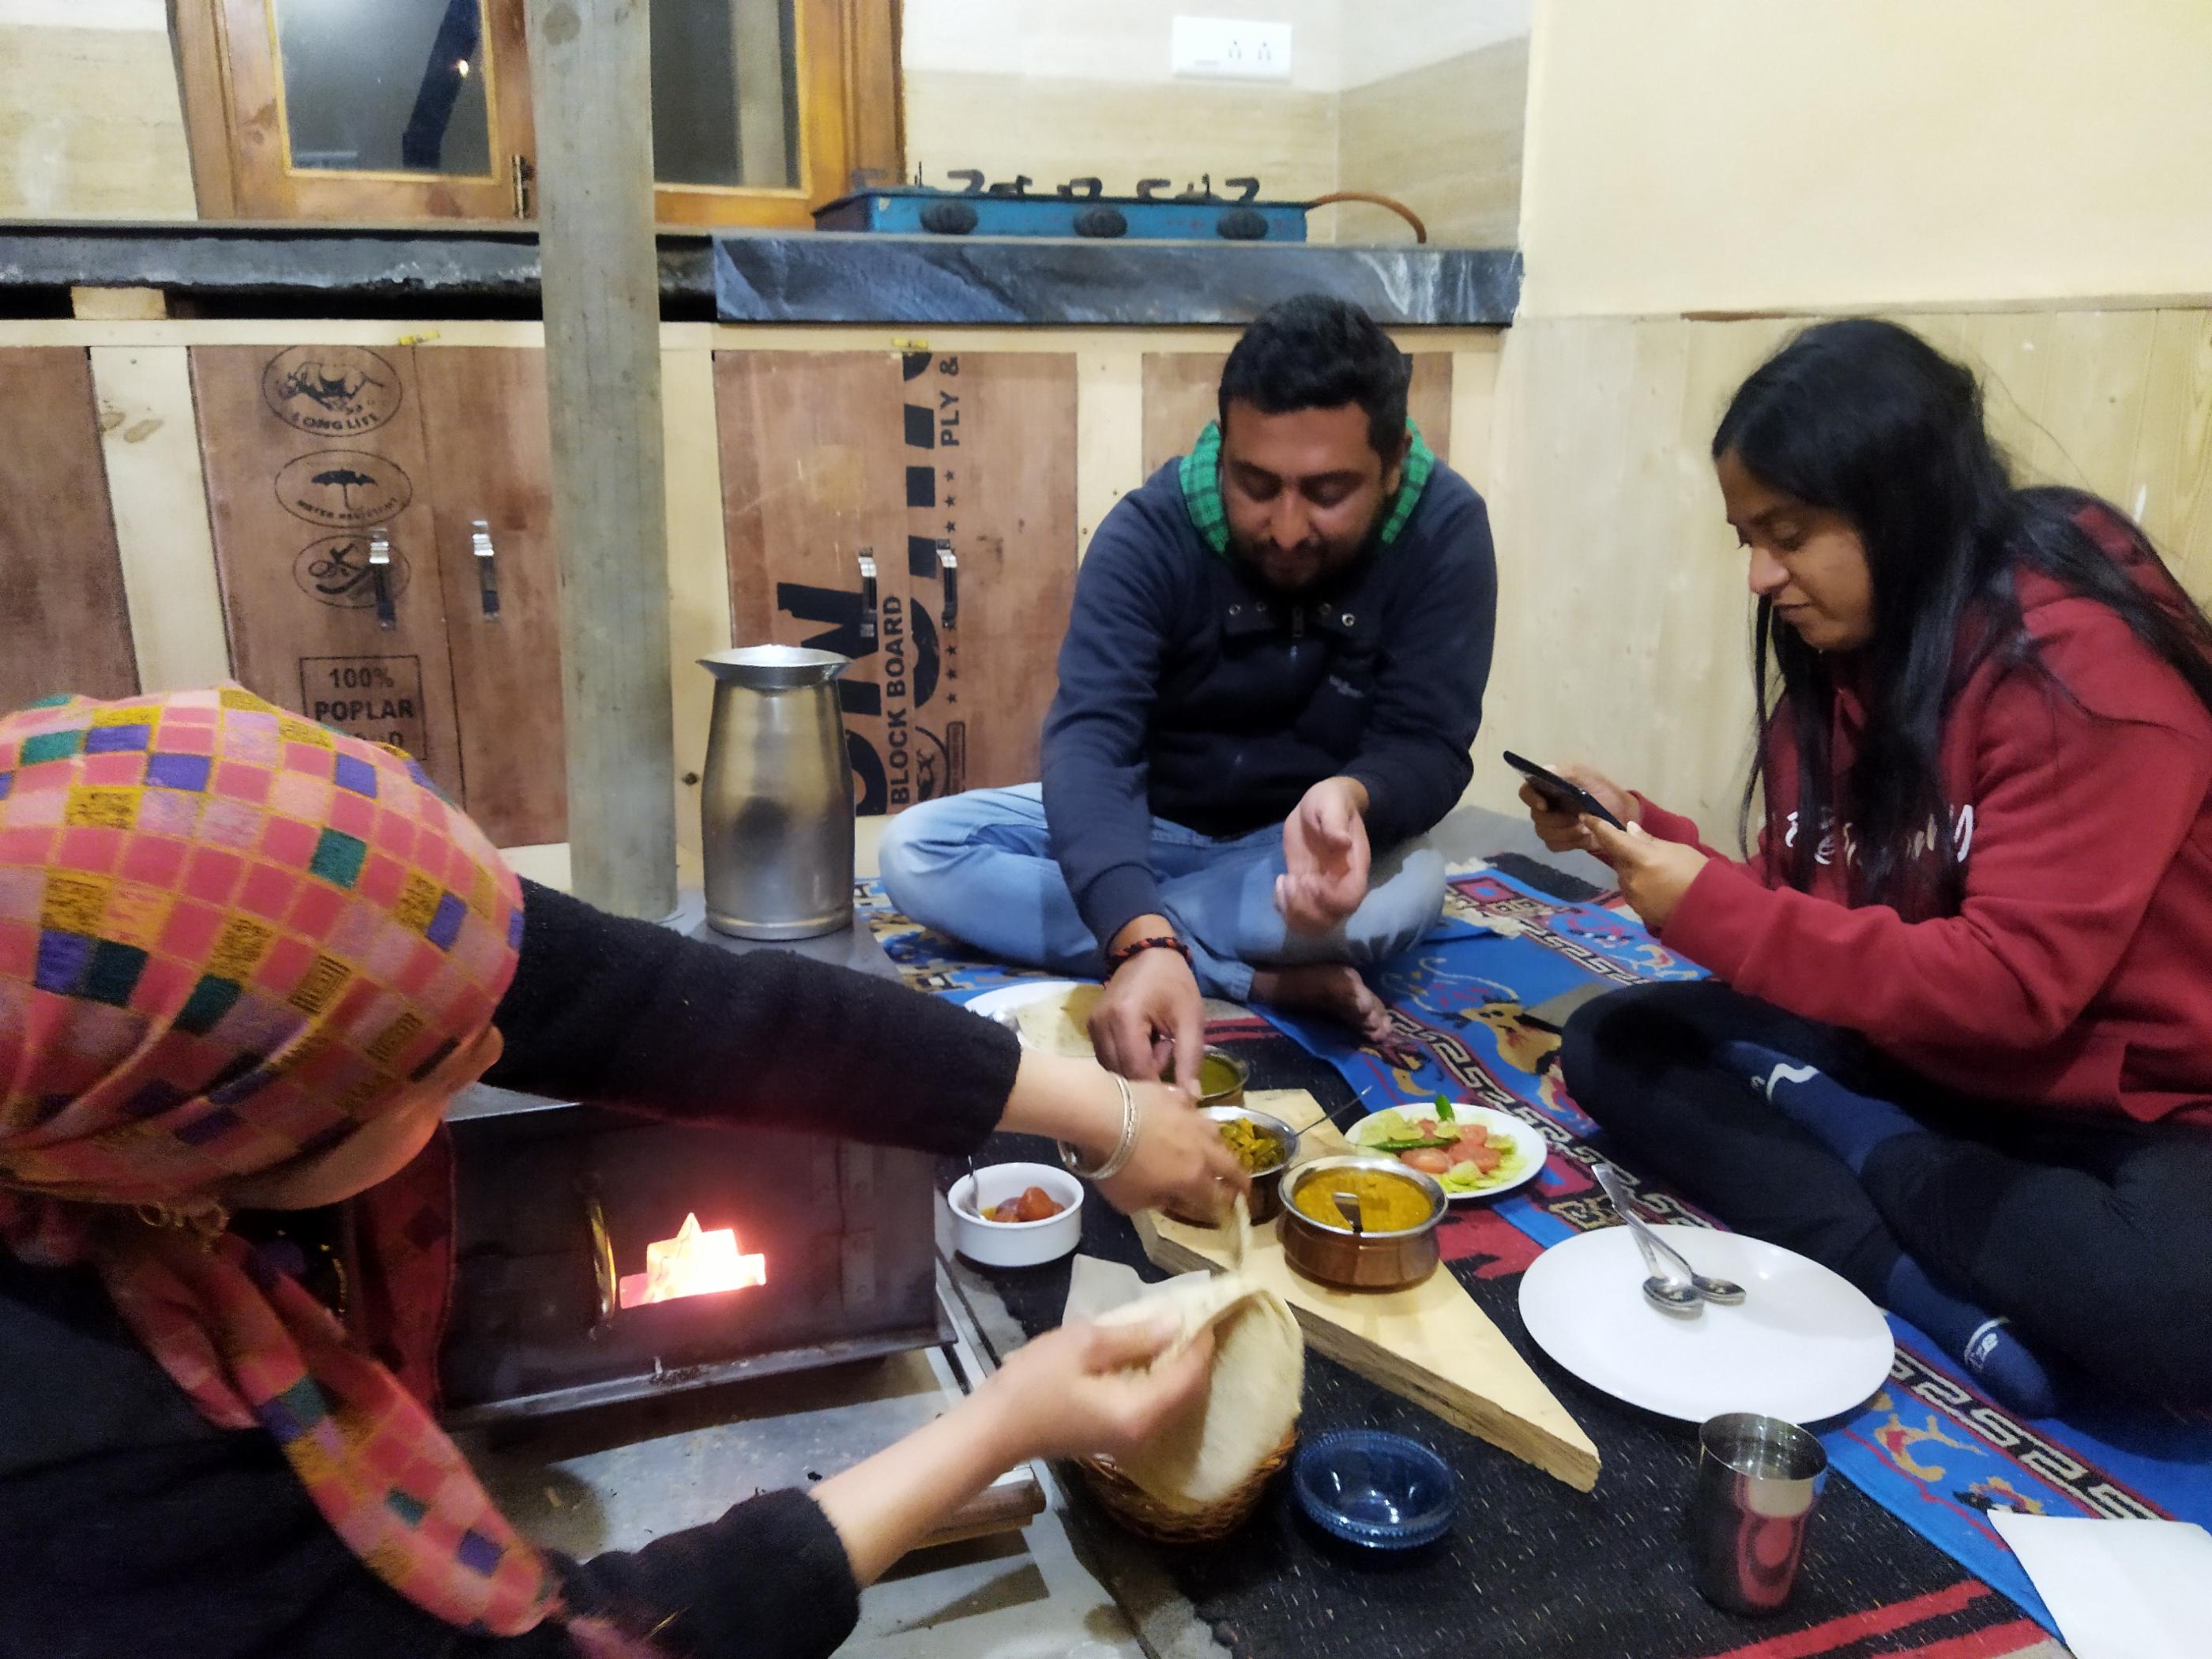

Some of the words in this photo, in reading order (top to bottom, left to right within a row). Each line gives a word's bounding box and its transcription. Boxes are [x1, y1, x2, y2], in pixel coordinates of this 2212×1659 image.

[939, 356, 960, 376] &
[292, 412, 343, 430] LONG
[939, 390, 960, 446] PLY
[882, 595, 907, 698] BOARD
[329, 668, 394, 689] 100%
[314, 699, 414, 722] POPLAR
[887, 708, 910, 805] BLOCK
